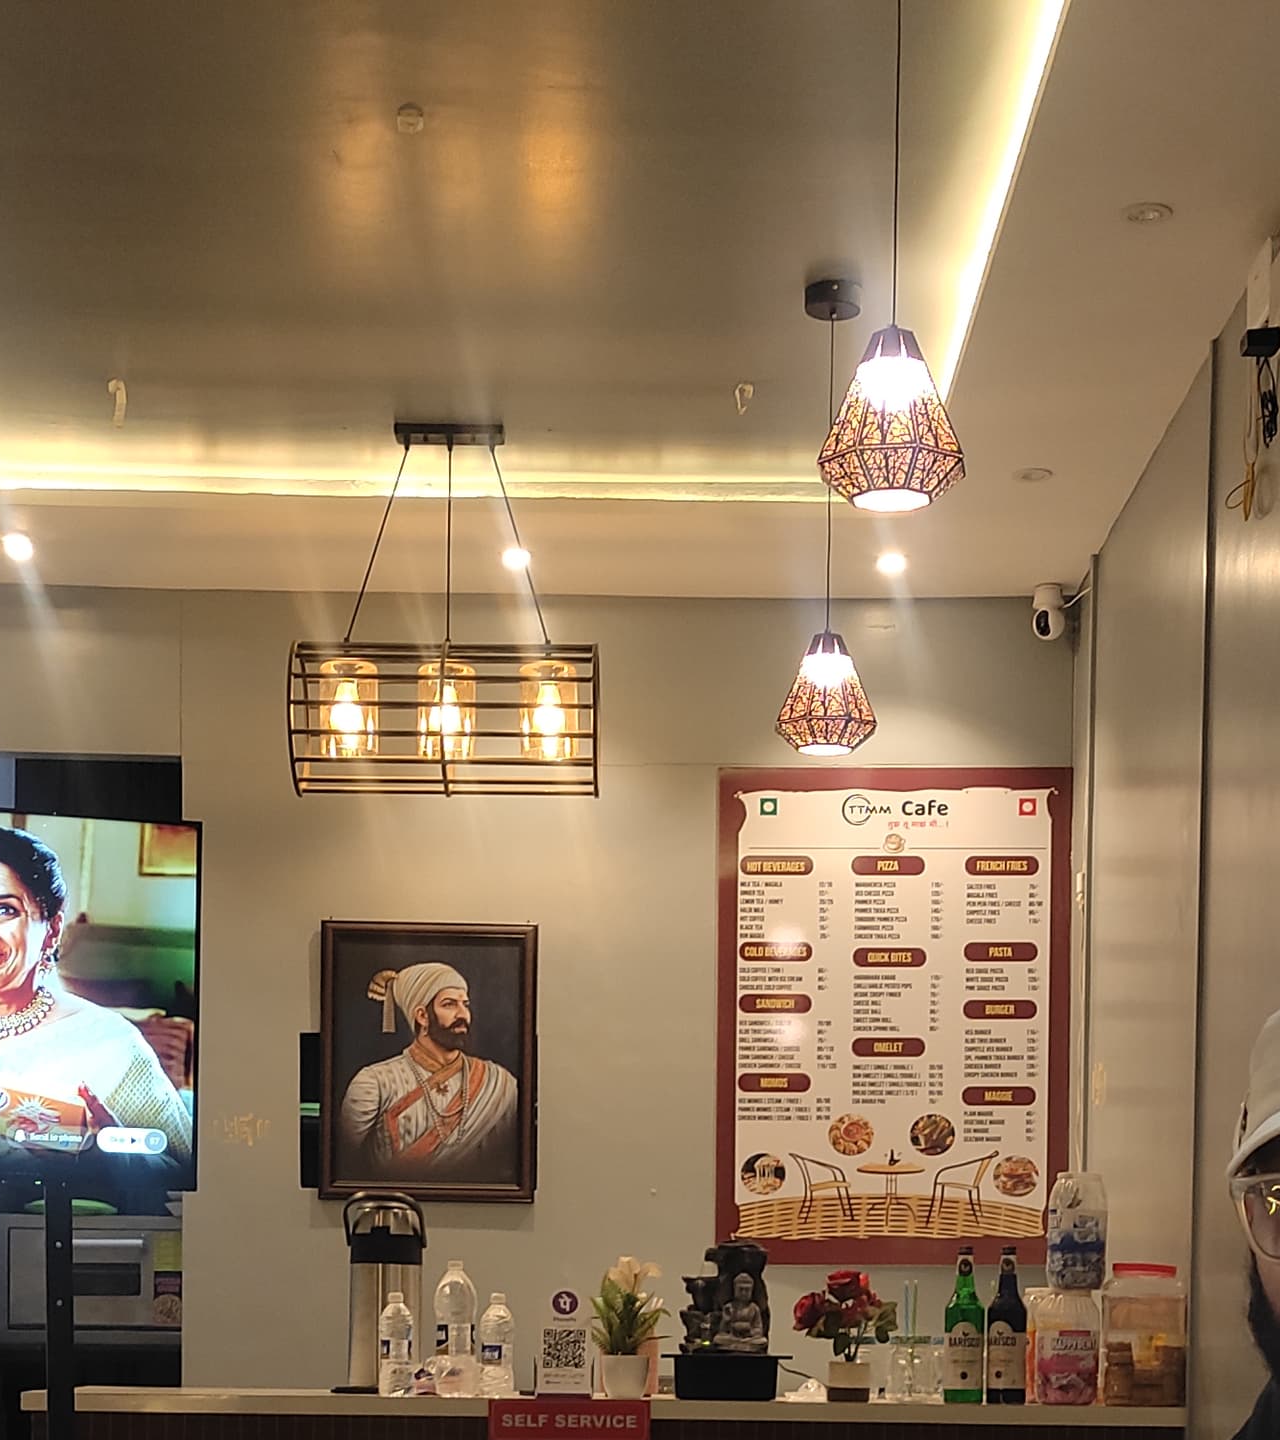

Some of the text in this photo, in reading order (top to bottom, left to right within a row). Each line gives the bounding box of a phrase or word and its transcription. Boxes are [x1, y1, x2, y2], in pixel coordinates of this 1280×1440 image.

[901, 799, 949, 816] Cafe
[762, 860, 805, 872] BEVERAGES
[876, 860, 899, 872] PIZZA
[744, 946, 764, 957] COLD
[988, 946, 1014, 958] PASTA
[873, 1041, 904, 1053] OMELET
[501, 1413, 638, 1429] SELF SERVICE
